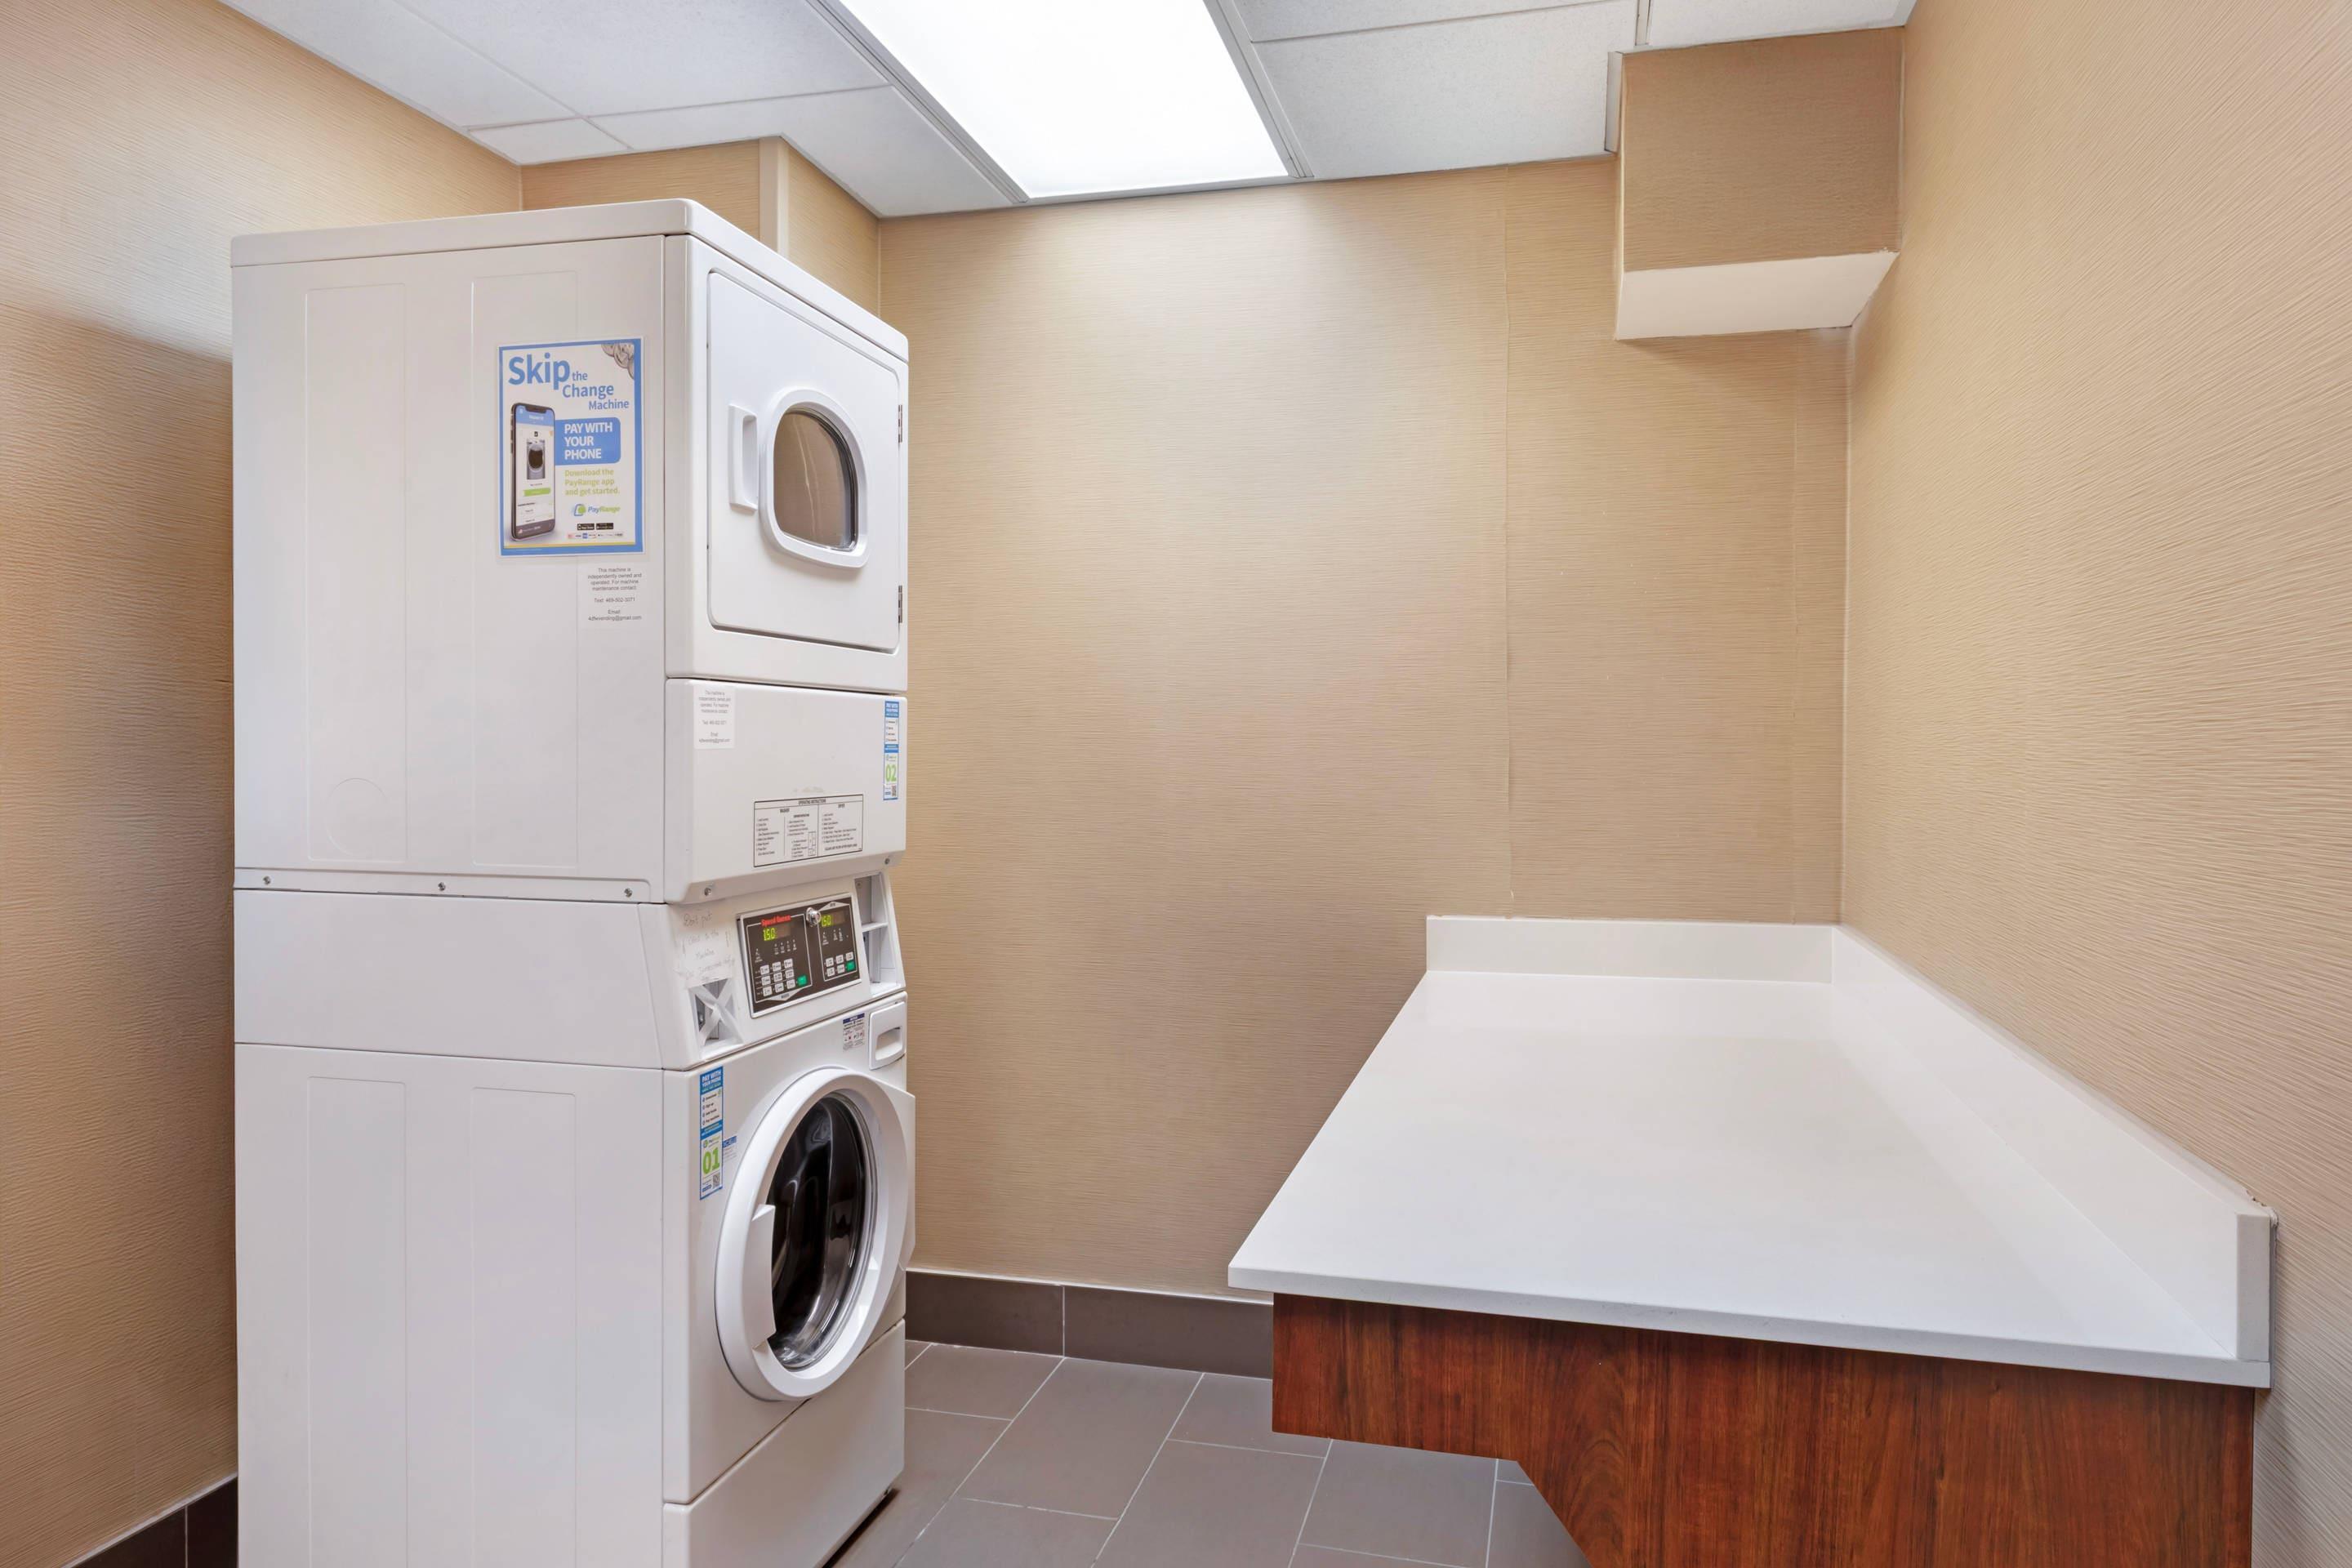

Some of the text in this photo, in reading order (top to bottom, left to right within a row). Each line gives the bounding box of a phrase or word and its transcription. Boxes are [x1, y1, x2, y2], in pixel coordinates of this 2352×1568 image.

[508, 352, 588, 390] Skip the
[562, 384, 614, 400] Change
[589, 399, 630, 410] Machine
[564, 422, 613, 434] PAY WITH
[564, 435, 595, 447] YOUR
[564, 448, 602, 460] PHONE
[564, 469, 600, 477] Download
[565, 488, 578, 496] and
[588, 506, 621, 514] PayRange
[885, 764, 897, 782] 02
[702, 1147, 720, 1174] 01
